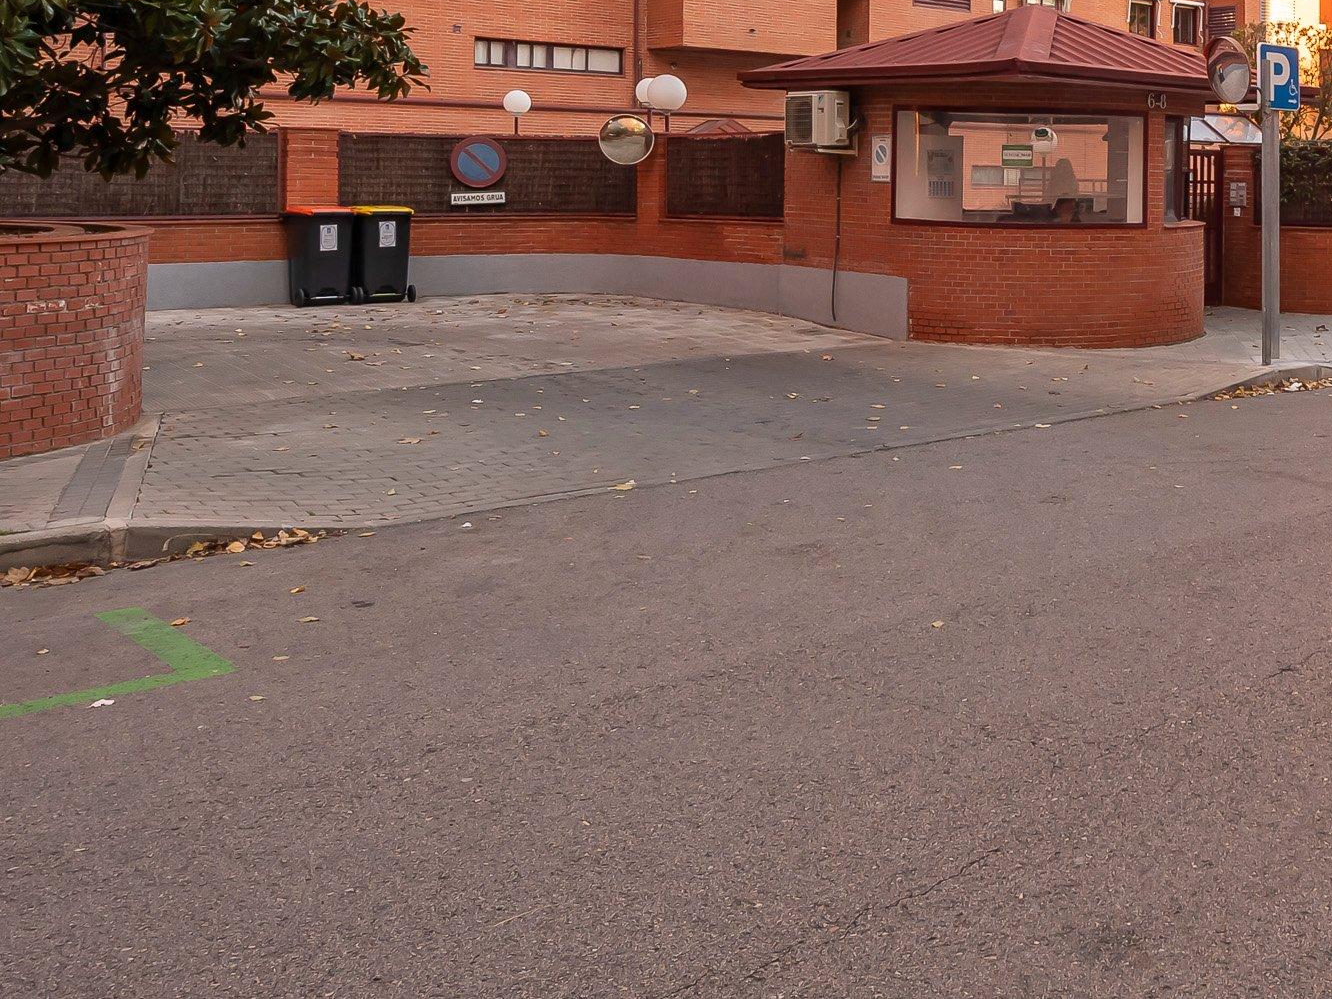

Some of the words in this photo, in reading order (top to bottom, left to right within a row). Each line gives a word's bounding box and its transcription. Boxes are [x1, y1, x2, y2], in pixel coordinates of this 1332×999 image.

[1266, 52, 1290, 101] P
[1148, 93, 1167, 109] 6-8
[453, 194, 485, 202] AVISAMOS
[486, 193, 504, 201] GRUA
